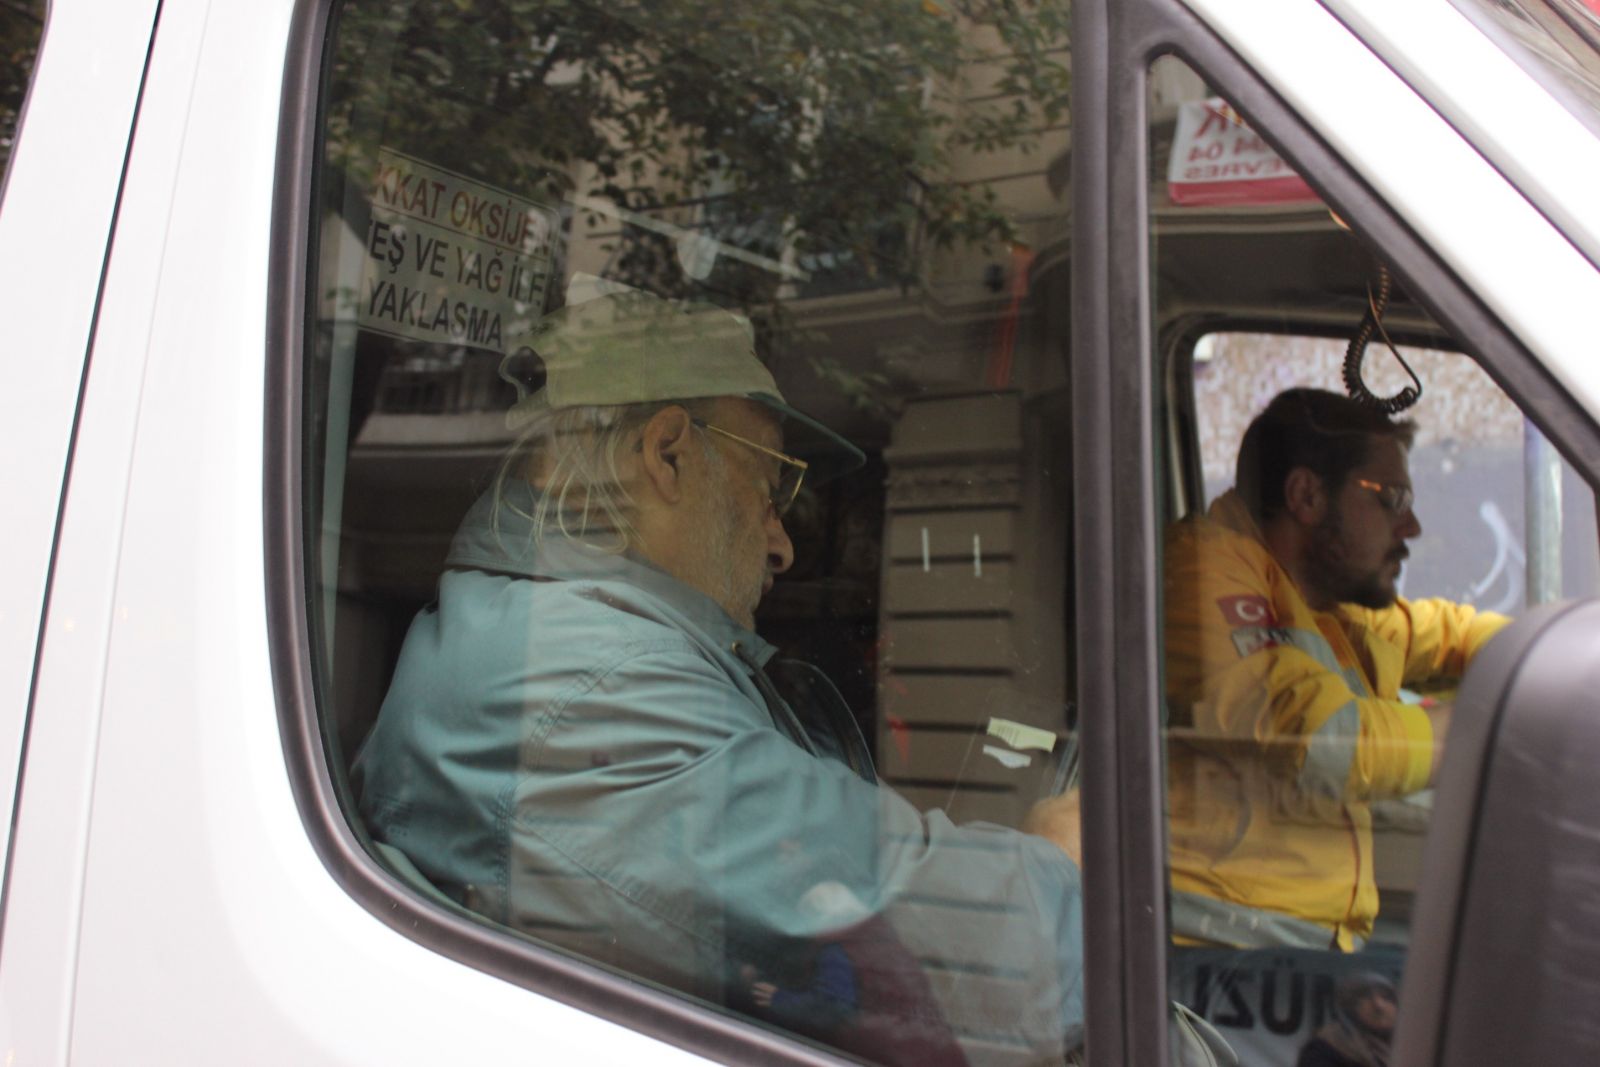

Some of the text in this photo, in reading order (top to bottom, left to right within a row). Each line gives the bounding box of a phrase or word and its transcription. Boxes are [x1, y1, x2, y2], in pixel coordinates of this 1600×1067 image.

[369, 219, 546, 306] EŞ VE YAĞ İLE
